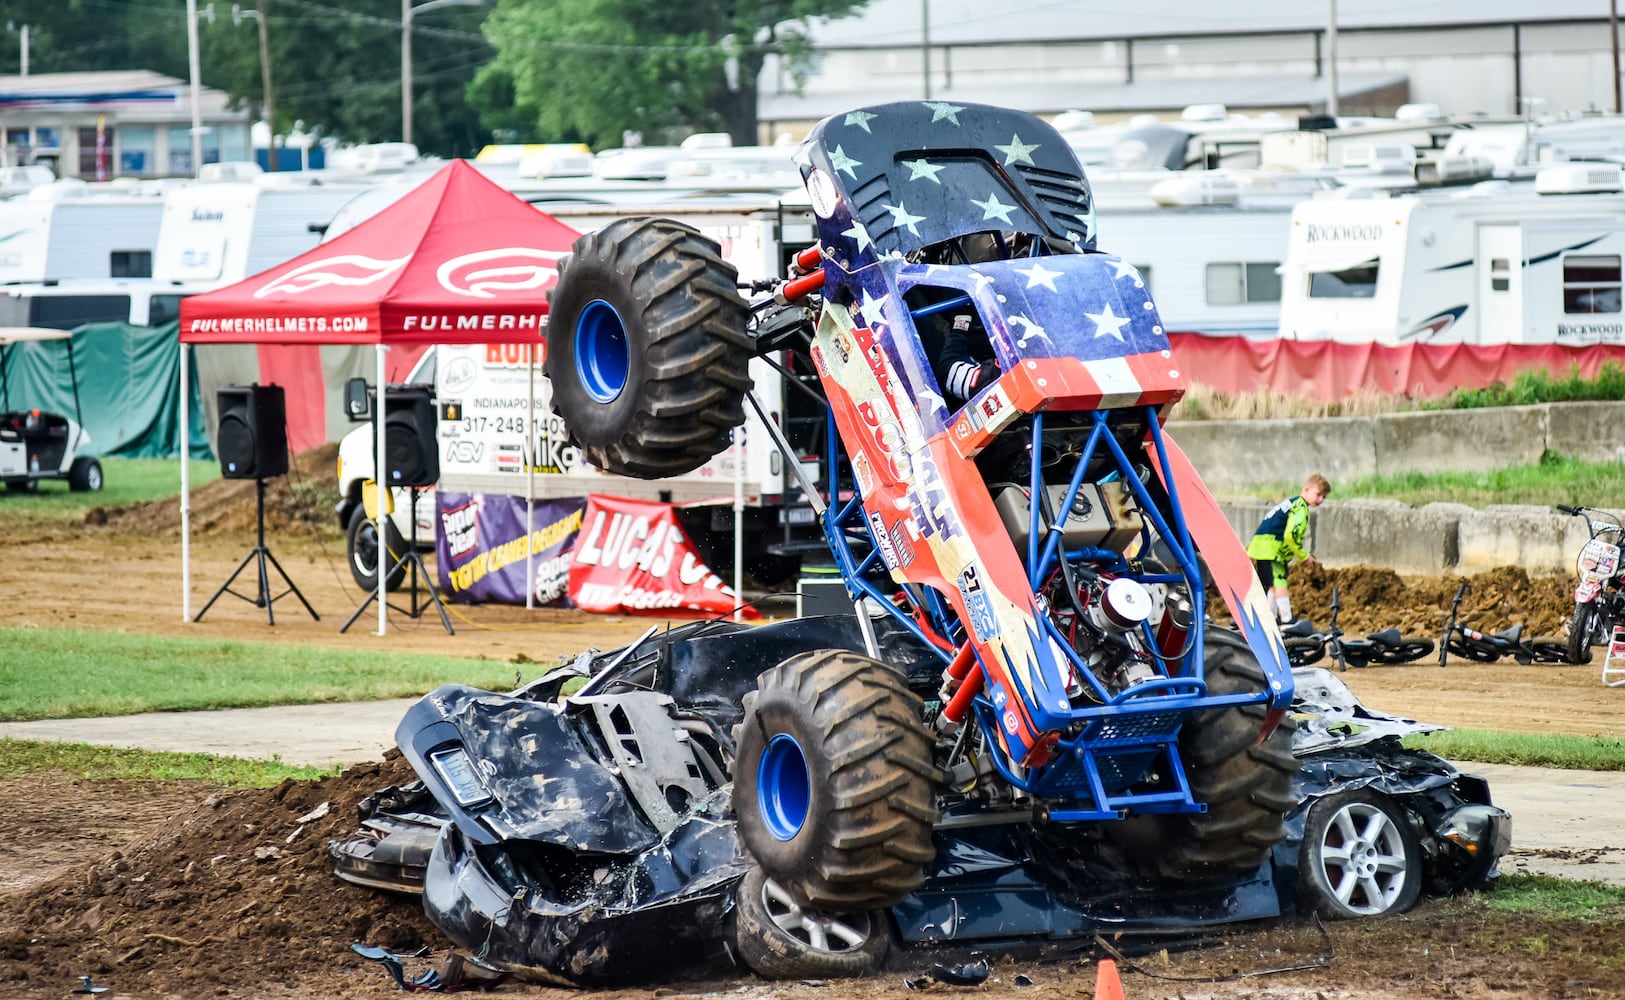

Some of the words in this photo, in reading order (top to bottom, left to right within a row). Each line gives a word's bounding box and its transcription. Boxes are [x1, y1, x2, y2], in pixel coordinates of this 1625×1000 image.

[1306, 223, 1383, 244] ROCKWOOD
[190, 316, 368, 334] FULMERHELMETS.COM
[1557, 322, 1623, 336] ROCKWOOD
[473, 398, 546, 410] INDIANAPOIS,
[576, 510, 684, 578] LUCAS
[871, 511, 900, 570] FIREWIRE
[963, 566, 981, 593] 27
